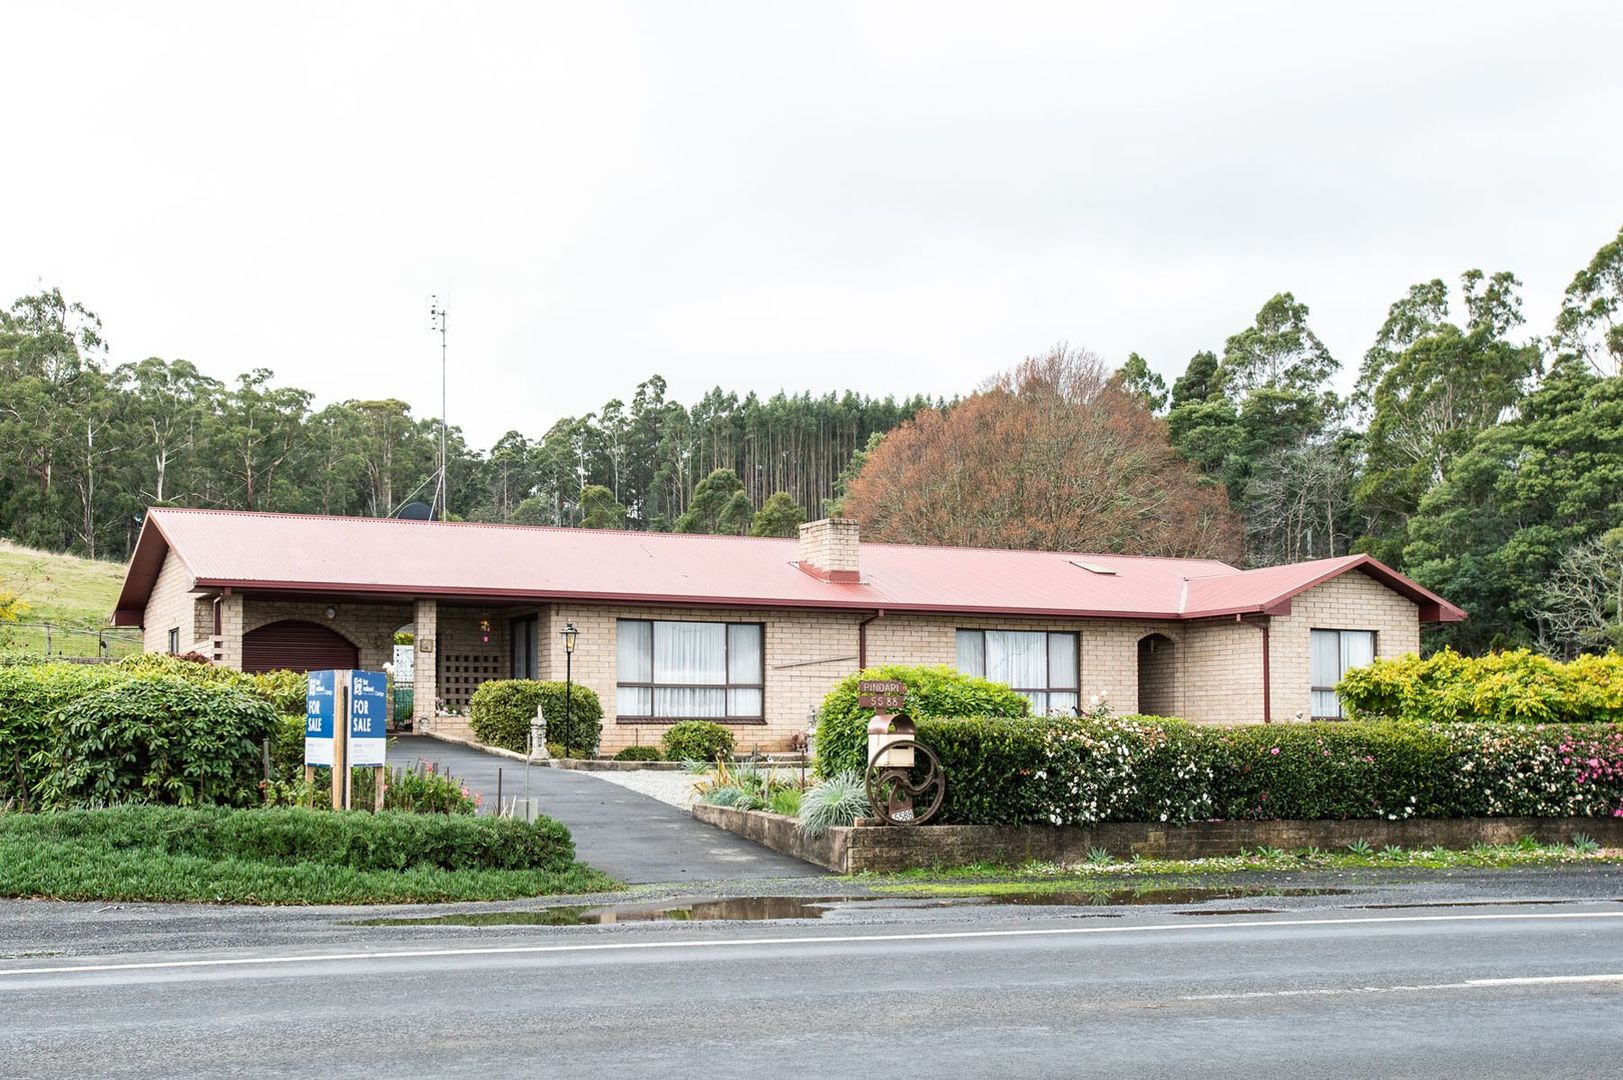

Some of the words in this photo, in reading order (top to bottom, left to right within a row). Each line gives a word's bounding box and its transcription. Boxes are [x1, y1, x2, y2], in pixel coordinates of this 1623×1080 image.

[309, 700, 320, 714] FOR
[353, 700, 369, 714] FOR
[308, 718, 322, 731] SALE
[353, 717, 371, 731] SALE
